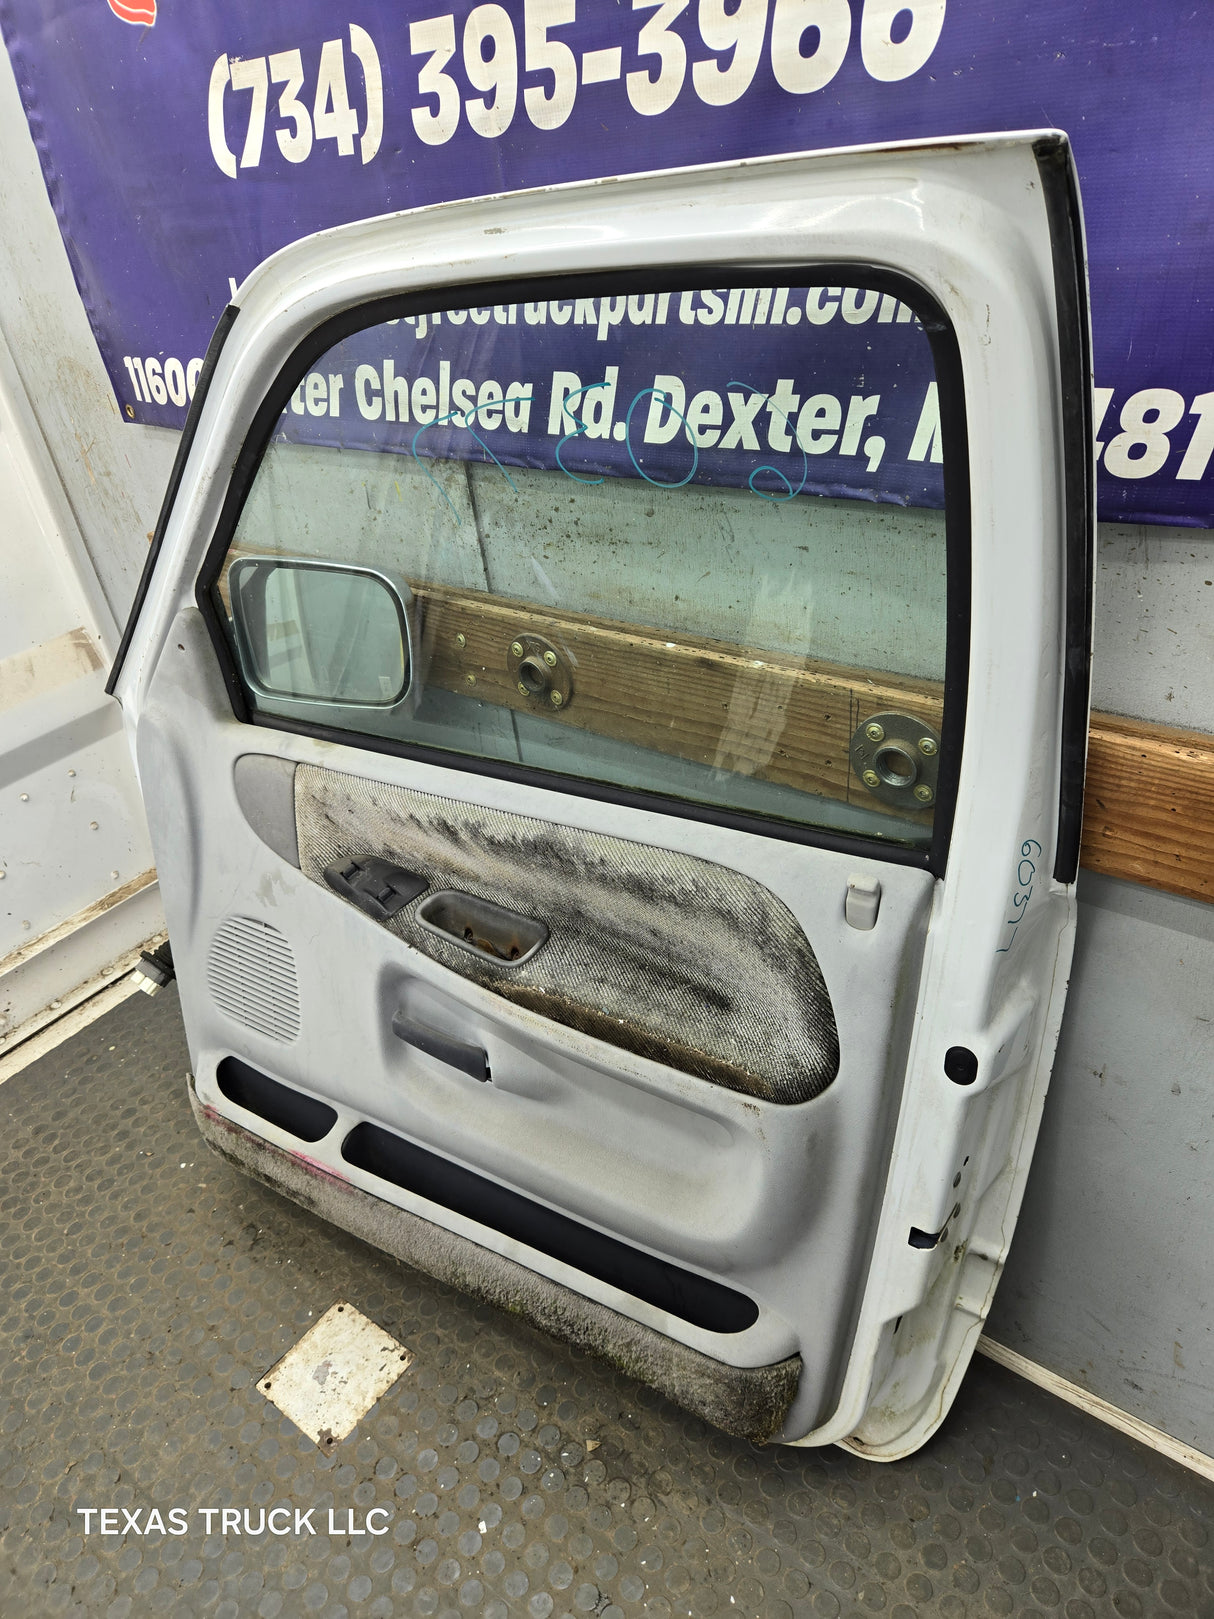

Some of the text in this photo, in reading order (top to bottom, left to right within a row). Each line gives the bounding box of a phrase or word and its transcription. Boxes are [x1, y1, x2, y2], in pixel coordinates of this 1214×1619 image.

[208, 23, 384, 179] (734)
[355, 359, 535, 433] Chelsea
[547, 365, 627, 442] Rd.
[643, 374, 886, 473] Dexter,
